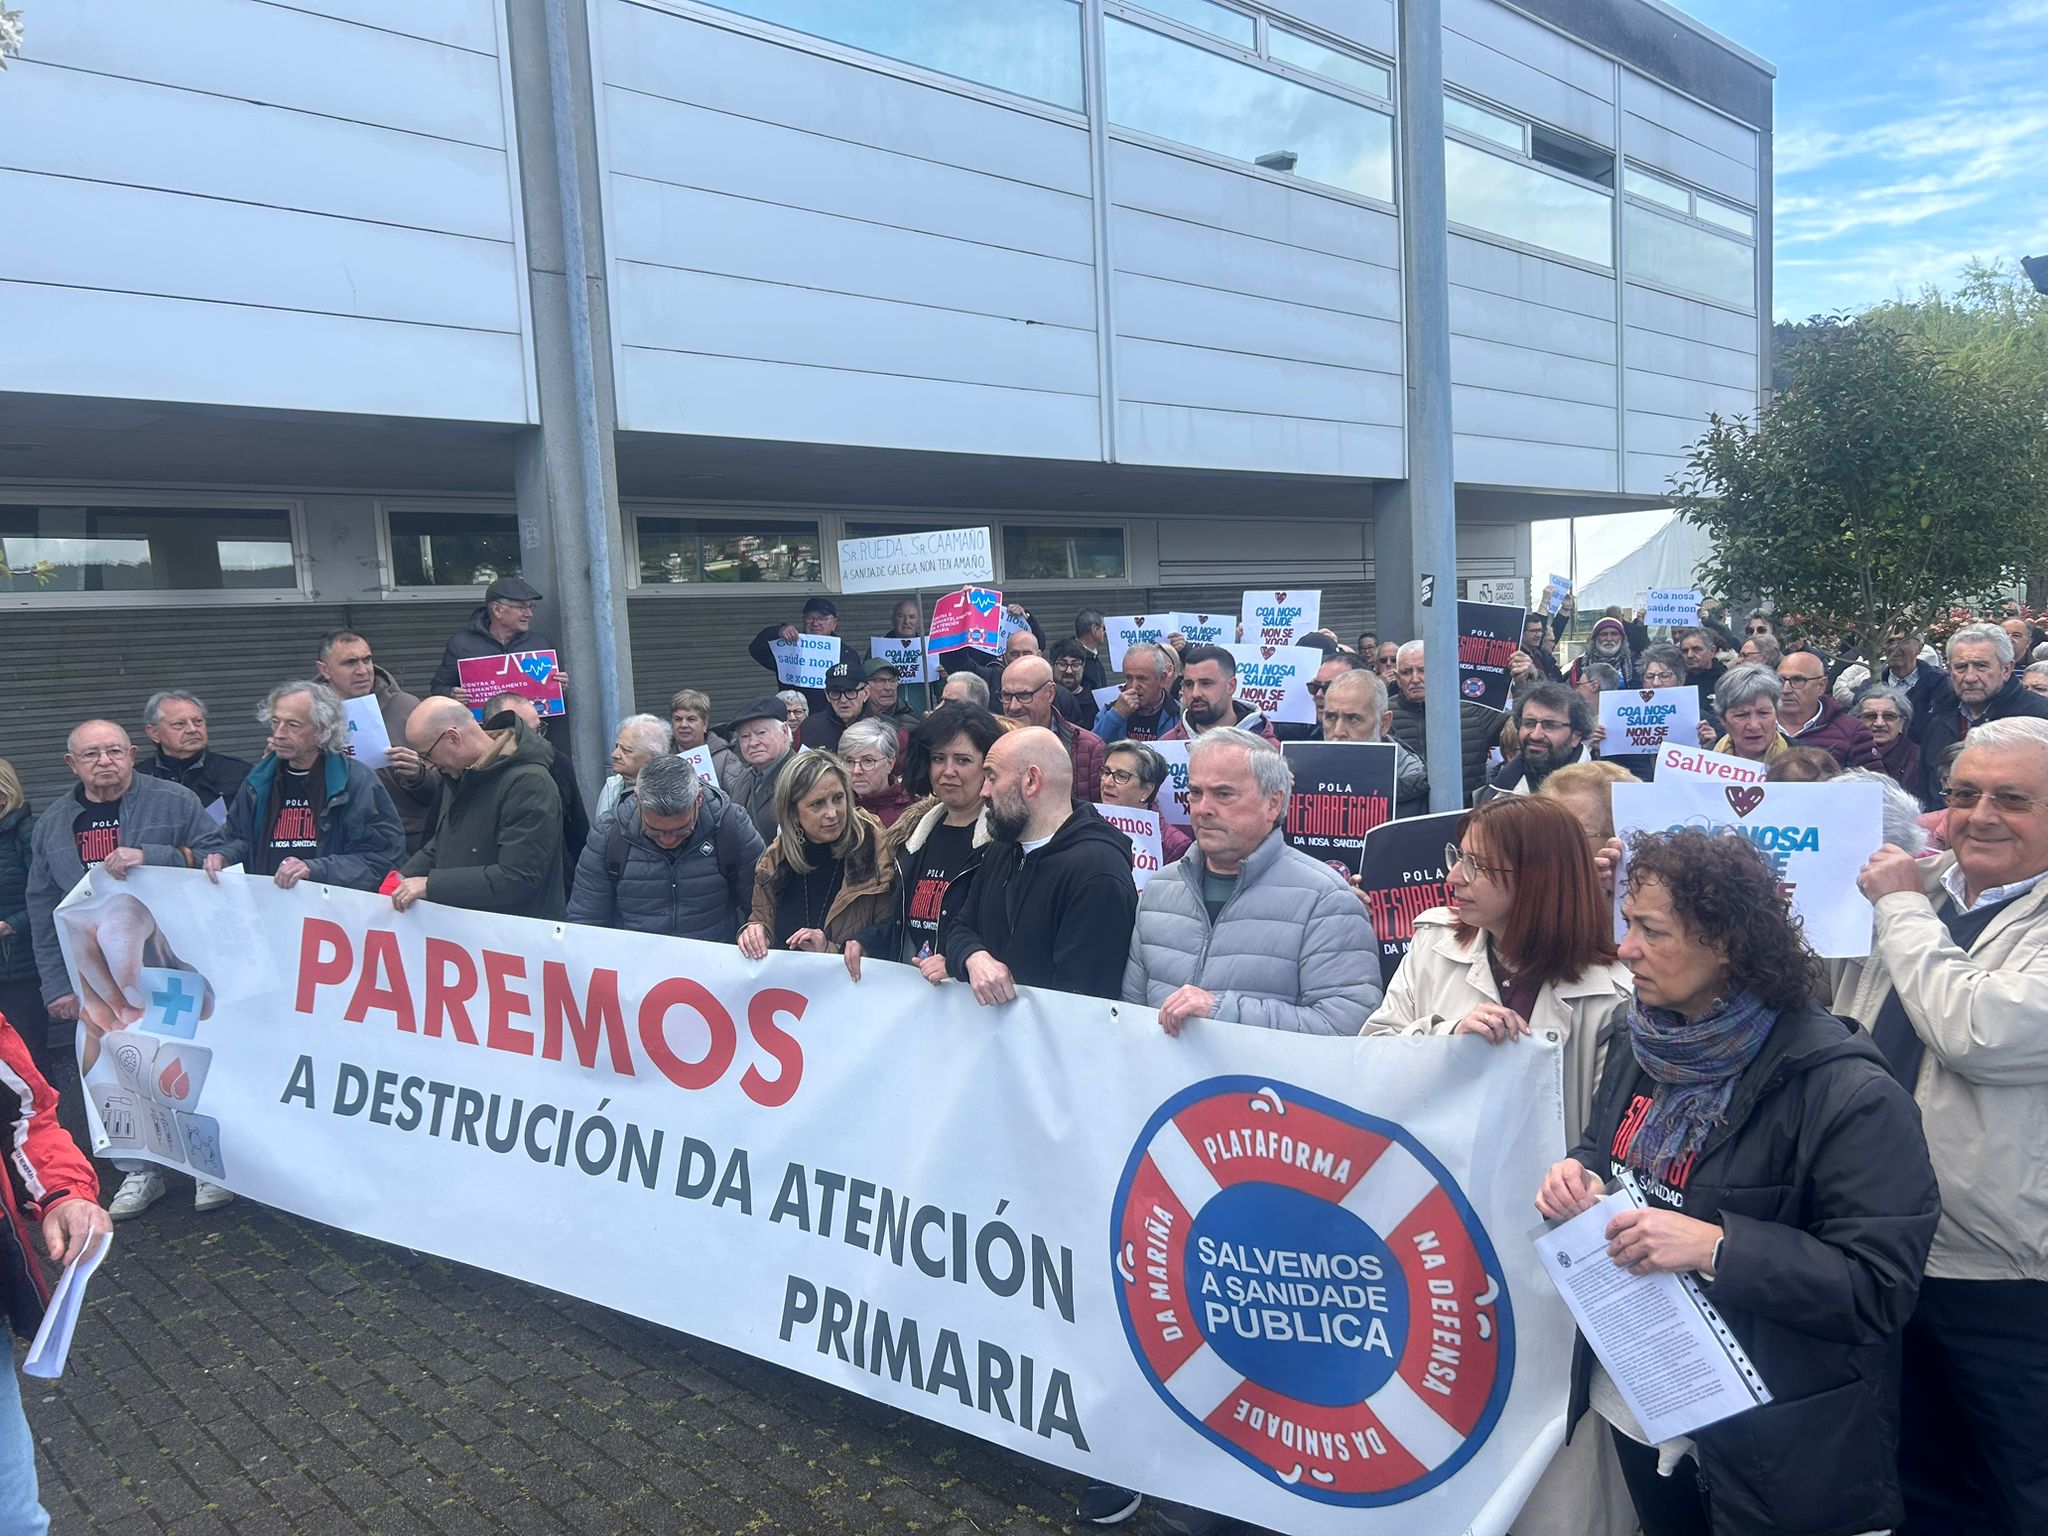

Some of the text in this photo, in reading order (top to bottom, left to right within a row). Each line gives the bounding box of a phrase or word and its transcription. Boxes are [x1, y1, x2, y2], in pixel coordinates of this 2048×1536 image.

[928, 530, 984, 554] CAAMAÑO
[843, 570, 849, 580] A
[920, 559, 936, 573] NON
[938, 558, 952, 570] TEN
[954, 554, 984, 569] AMAÑO
[1651, 591, 1668, 600] Coa
[1256, 607, 1302, 617] COA NOSA
[1648, 602, 1676, 612] saúde
[1664, 617, 1689, 626] xoga
[1120, 630, 1162, 639] COA NOSA
[1180, 626, 1222, 636] COA NOSA
[1260, 628, 1294, 638] NON SE
[1471, 629, 1494, 638] POLA
[801, 638, 831, 650] nosa
[885, 650, 902, 658] COA
[778, 654, 834, 668] saúde non
[1236, 662, 1296, 676] COA NOSA
[786, 674, 823, 687] se xoga
[1240, 688, 1286, 700] NON SE
[1617, 704, 1676, 717] COA NOSA
[1626, 726, 1669, 737] NON SE
[1631, 736, 1663, 746] XOGA
[1318, 783, 1352, 793] POLA
[92, 819, 119, 828] POLA
[1294, 836, 1364, 848] DA NOSA SANIDA
[926, 868, 945, 878] POLA
[1403, 868, 1444, 882] POLA
[1384, 943, 1398, 954] DA
[295, 916, 809, 1108] PAREMOS
[1203, 1128, 1352, 1184] PLATAFORMA
[280, 1054, 1075, 1324] A DESTRUCIÓN DA ATENCIÓN
[1198, 1235, 1384, 1281] SALVEMOS
[1144, 1204, 1184, 1342] DA MARIÑA
[1202, 1271, 1390, 1313] A SANIDADE
[1412, 1229, 1462, 1397] NA DEFENSA
[1206, 1298, 1394, 1359] PÚBLICA
[778, 1274, 1092, 1454] PRIMARIA
[1233, 1398, 1388, 1462] DA SANIDADE
